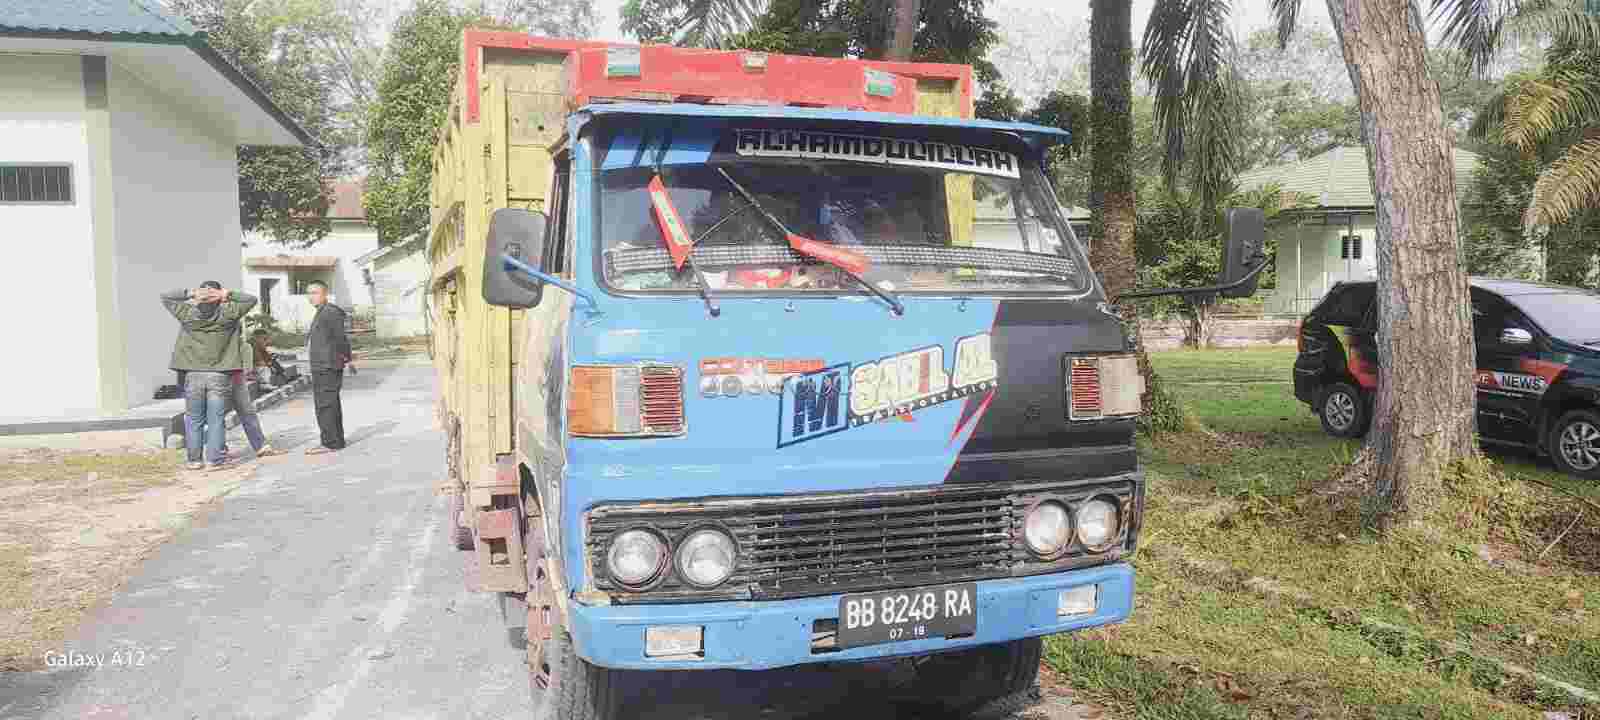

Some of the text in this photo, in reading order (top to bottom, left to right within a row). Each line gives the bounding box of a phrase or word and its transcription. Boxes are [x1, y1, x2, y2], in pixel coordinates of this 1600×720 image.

[736, 129, 1019, 178] ALHAMDULILLAH
[1502, 375, 1544, 390] NEWS
[847, 589, 972, 628] BB 8248 RA
